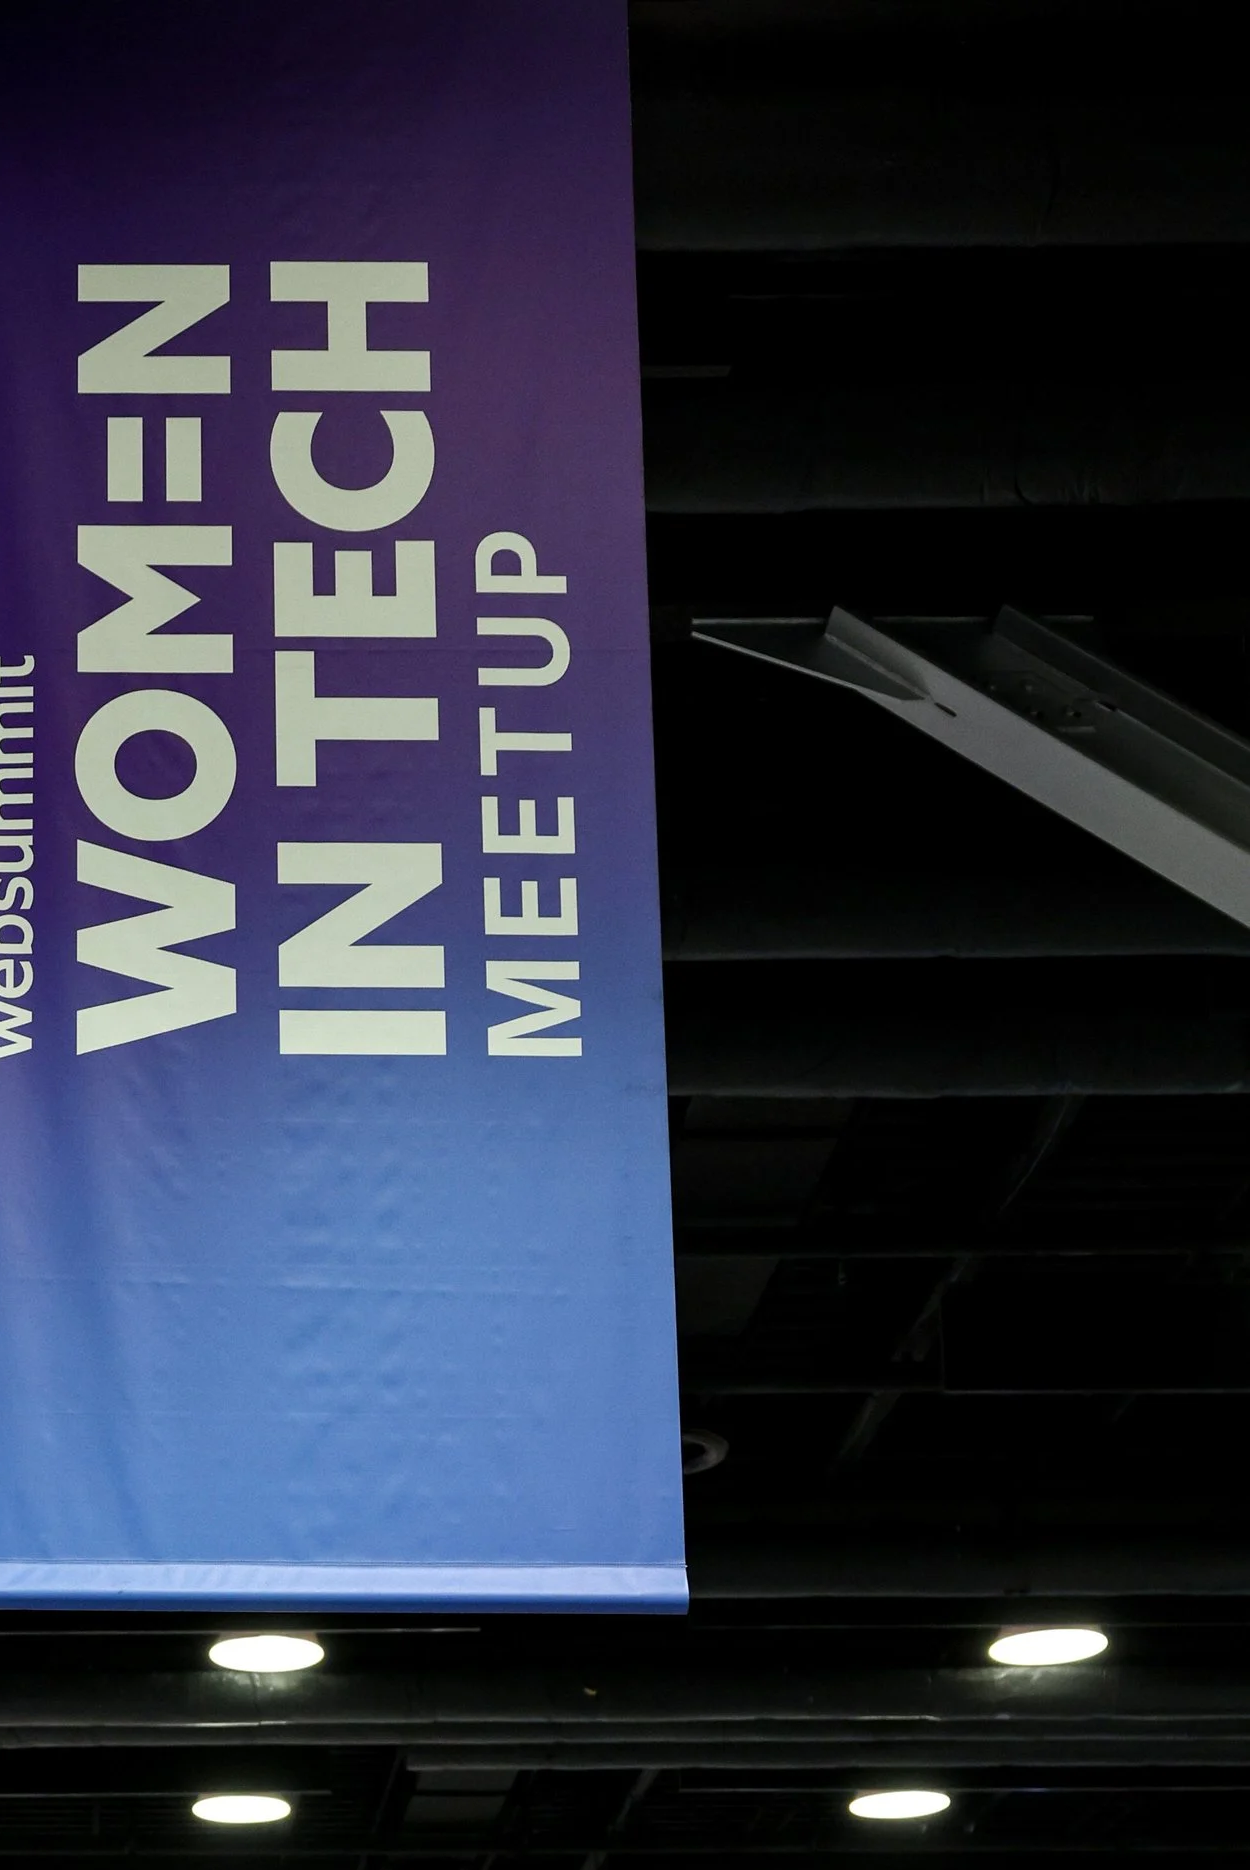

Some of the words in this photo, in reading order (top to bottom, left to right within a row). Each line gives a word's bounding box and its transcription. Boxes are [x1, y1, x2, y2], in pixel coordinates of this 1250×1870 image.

[269, 262, 440, 787] TECH
[277, 843, 447, 1056] IN
[475, 532, 583, 1056] MEETUP
